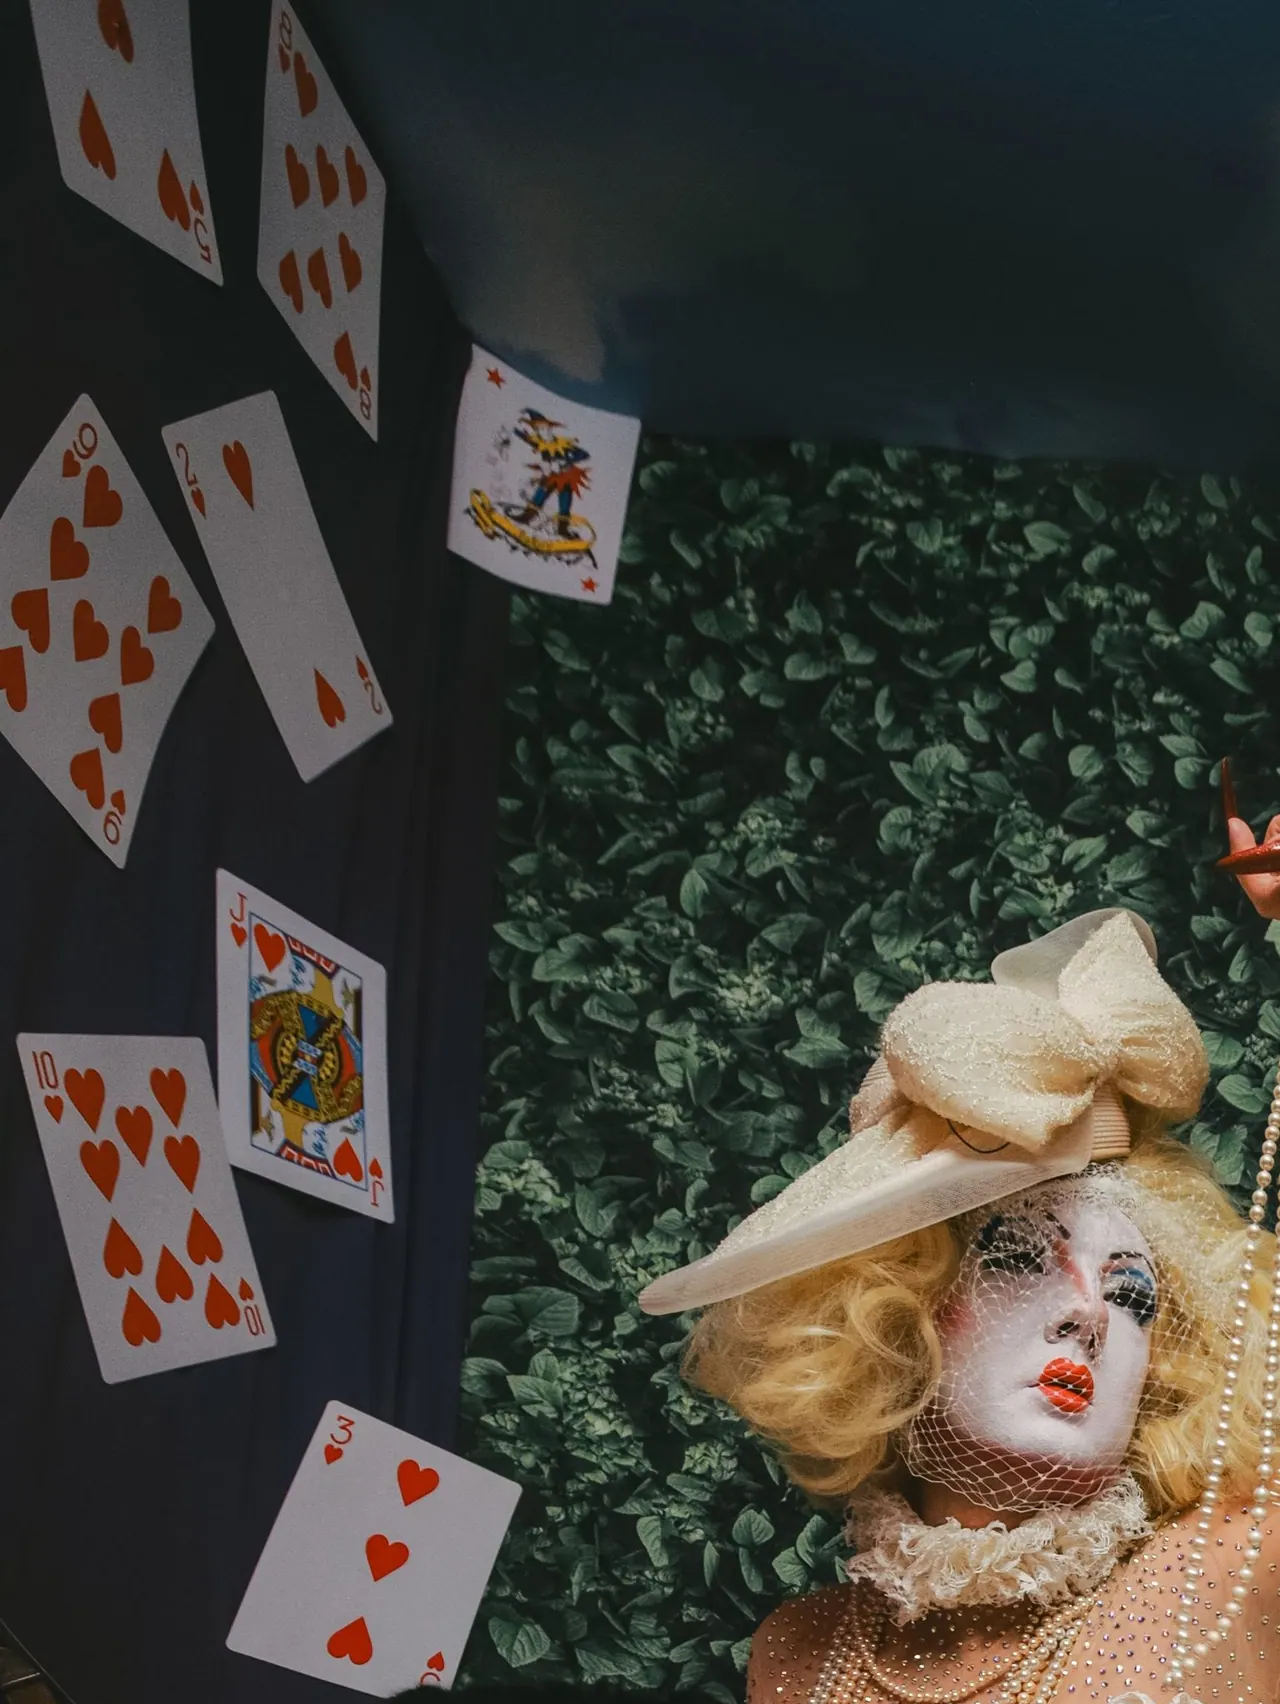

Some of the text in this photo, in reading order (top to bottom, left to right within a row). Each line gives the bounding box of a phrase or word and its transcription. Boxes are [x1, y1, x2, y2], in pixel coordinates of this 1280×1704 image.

[279, 11, 292, 50] 8
[194, 217, 212, 264] 5
[360, 387, 371, 420] 8
[72, 422, 98, 460] 9
[175, 442, 198, 486] 2
[363, 680, 384, 715] 2
[103, 811, 122, 845] 9
[229, 891, 248, 922] J
[32, 1050, 59, 1089] 10
[370, 1180, 385, 1207] J
[244, 1304, 266, 1336] 10
[330, 1415, 355, 1445] 3
